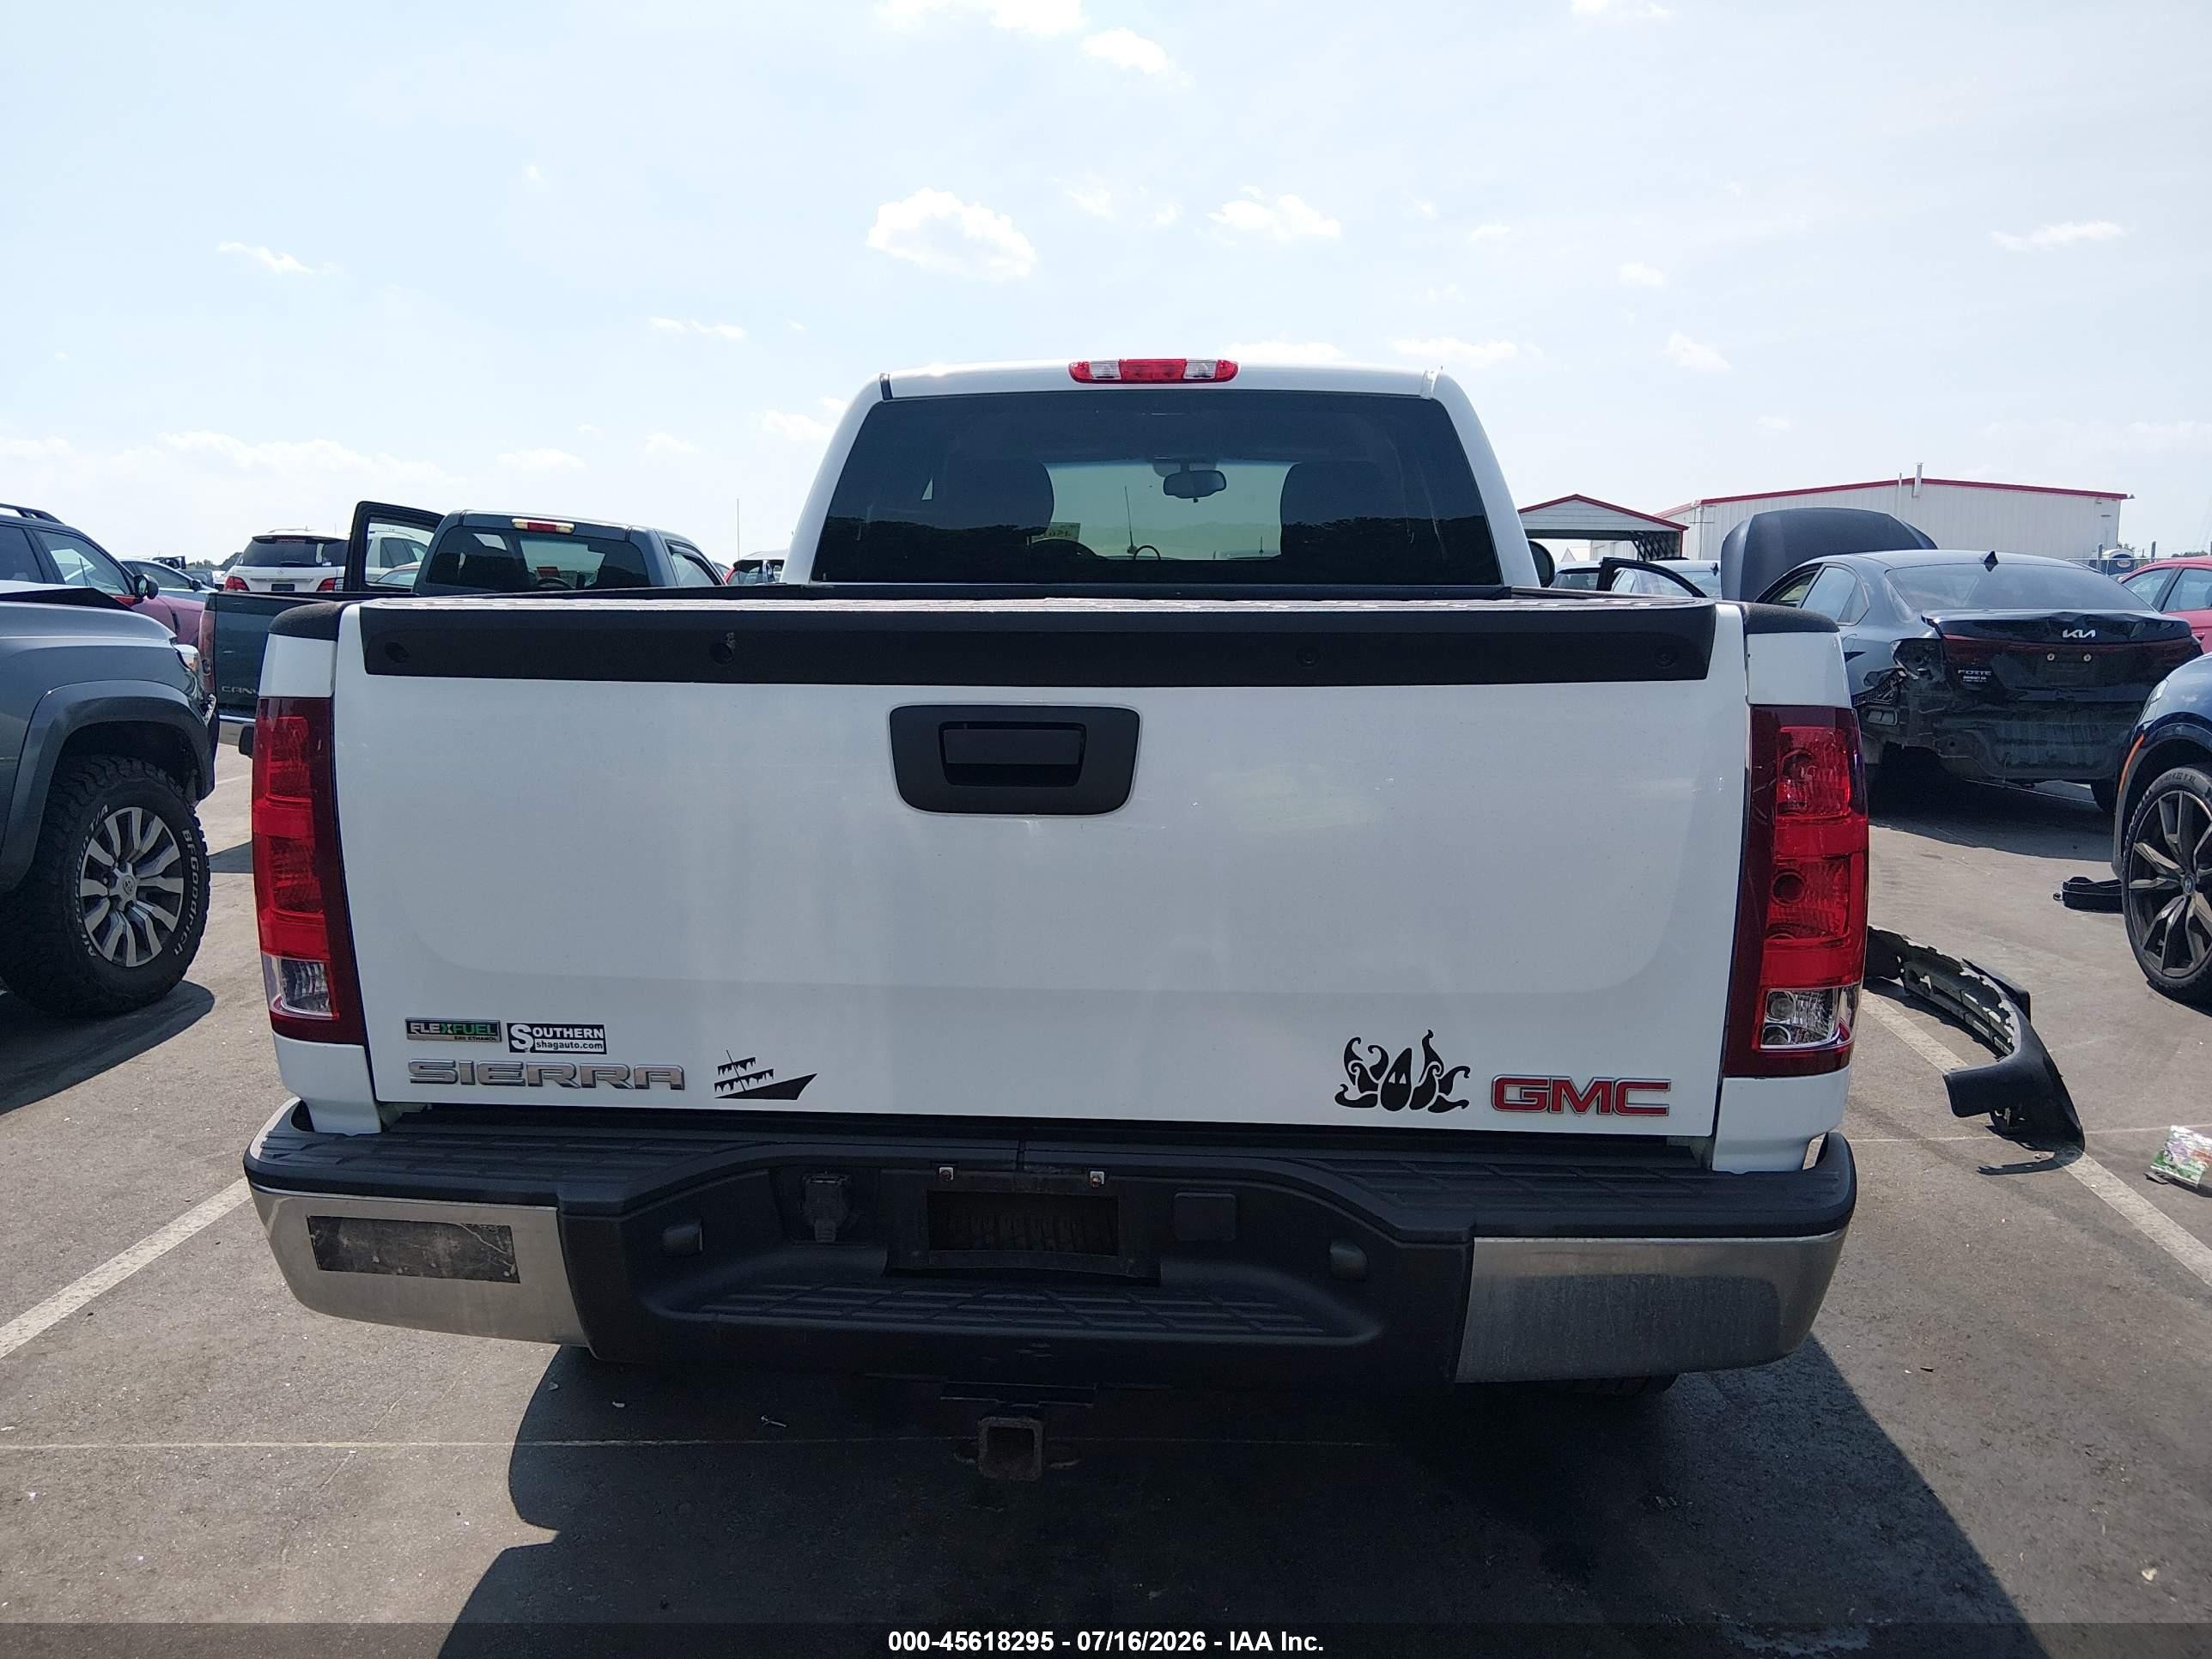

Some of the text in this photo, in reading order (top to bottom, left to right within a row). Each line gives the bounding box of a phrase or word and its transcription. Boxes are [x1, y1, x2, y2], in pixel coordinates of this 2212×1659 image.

[174, 830, 199, 955] BFGoodrich
[410, 1022, 497, 1036] FLEXFUEL
[510, 1024, 605, 1049] SOUTHERN
[536, 1040, 603, 1050] shagauto.com
[408, 1058, 685, 1091] SIERRA
[1491, 1074, 1672, 1117] GMC
